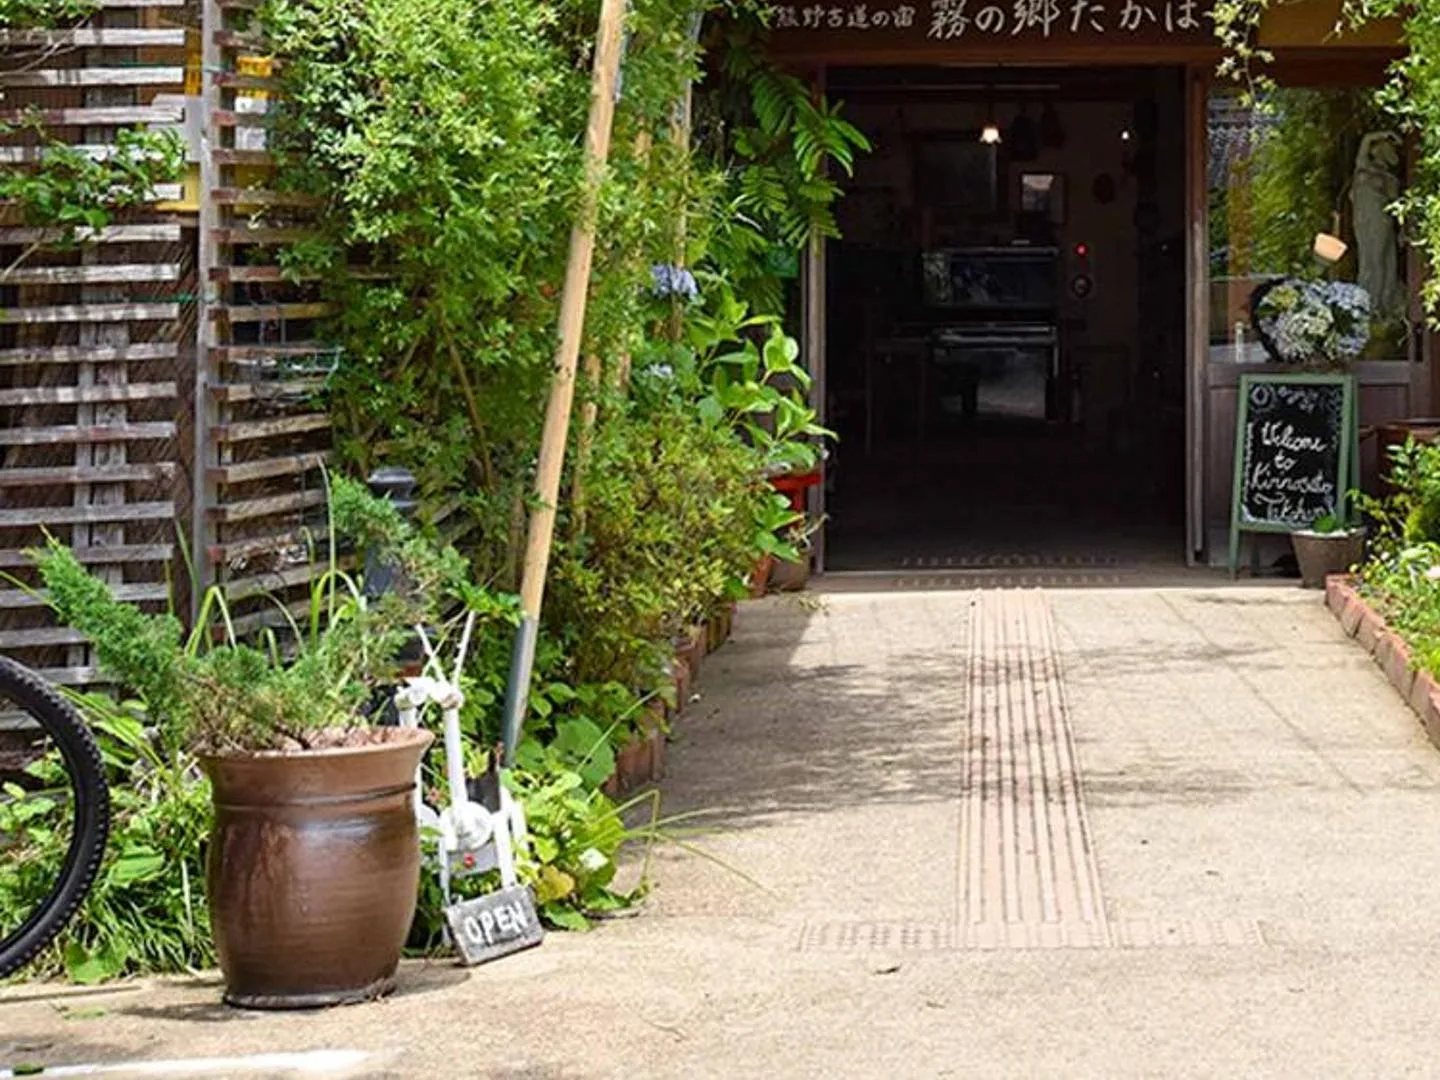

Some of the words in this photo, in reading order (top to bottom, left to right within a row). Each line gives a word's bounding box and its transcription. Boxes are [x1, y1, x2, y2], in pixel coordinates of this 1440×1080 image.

[1261, 421, 1327, 452] Welcome
[1274, 450, 1297, 470] to
[465, 901, 529, 945] OPEN
